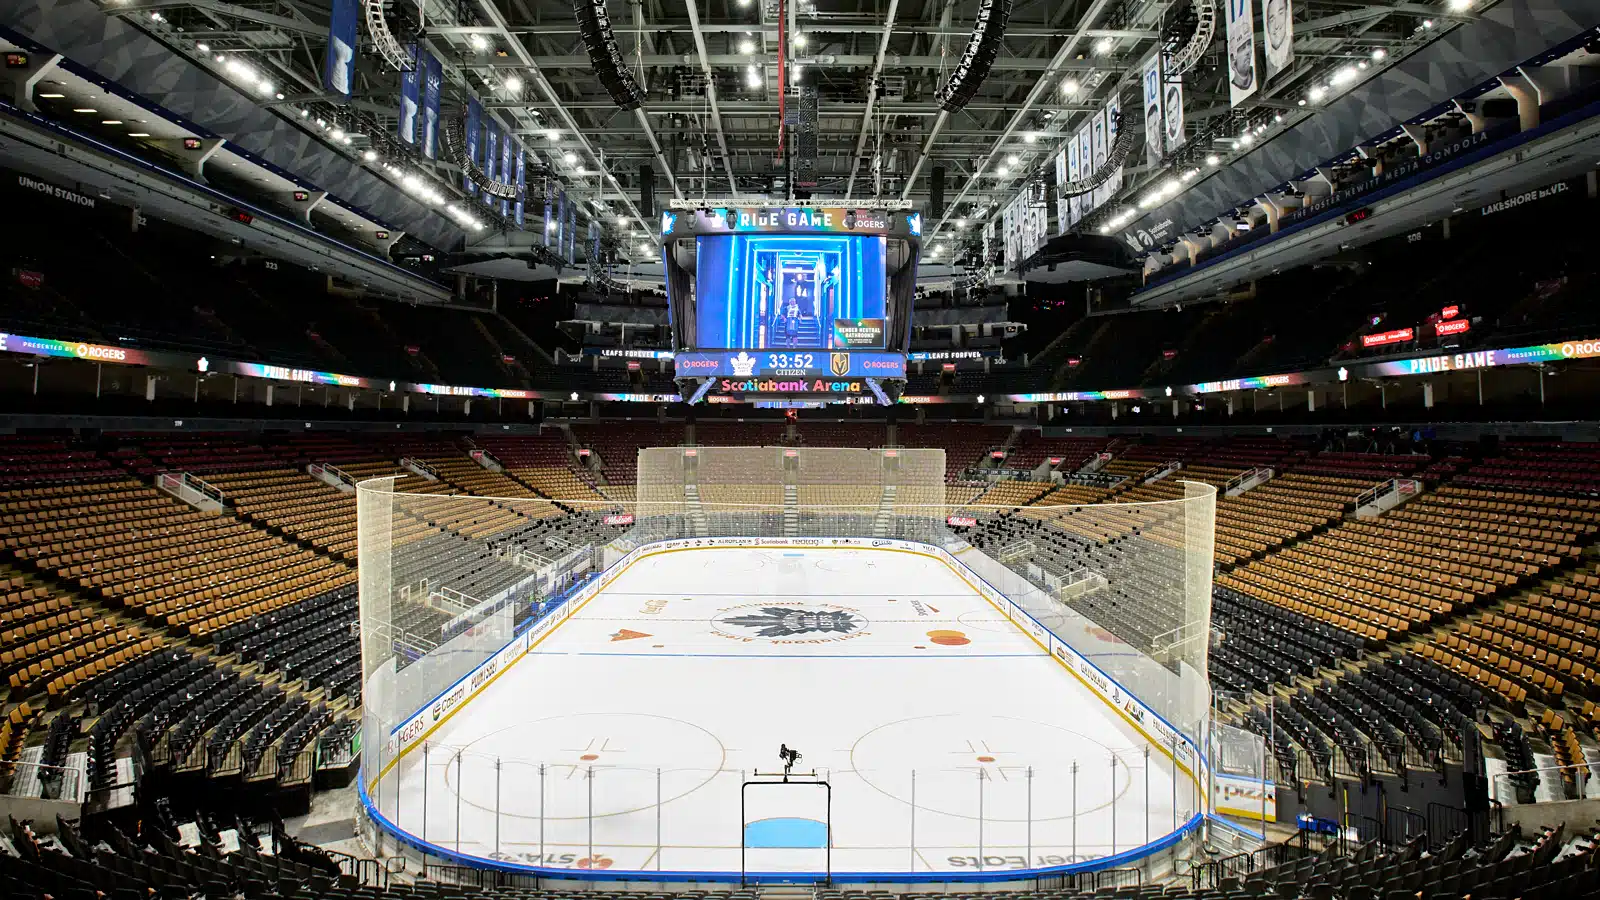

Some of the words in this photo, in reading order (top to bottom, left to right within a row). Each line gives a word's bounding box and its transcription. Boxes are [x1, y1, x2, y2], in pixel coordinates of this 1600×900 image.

[1293, 209, 1306, 220] THE
[1310, 193, 1341, 212] FOSTER
[1345, 177, 1380, 199] HEWITT
[1385, 161, 1419, 180] MEDIA
[1425, 133, 1488, 164] GONDOLA
[18, 176, 53, 195] UNION
[54, 187, 95, 208] STATION
[1482, 190, 1537, 216] LAKESHORE
[787, 213, 832, 227] GAME
[1443, 323, 1466, 332] ROGERS
[23, 341, 63, 351] PRESENTED
[88, 347, 126, 360] ROGERS
[602, 349, 623, 357] LEAFS
[768, 353, 813, 369] 33:52
[1410, 356, 1450, 373] PRIDE
[1455, 351, 1496, 369] GAME
[1507, 350, 1546, 359] PRESENTED
[263, 365, 290, 380] PRIDE
[292, 369, 314, 382] GAME
[453, 386, 473, 396] GAME
[721, 378, 809, 391] Scotiabank
[812, 379, 861, 392] Arena
[624, 394, 649, 402] PRIDE
[1056, 392, 1079, 400] GAME
[441, 685, 465, 712] Castrol
[947, 855, 1028, 869] Eats
